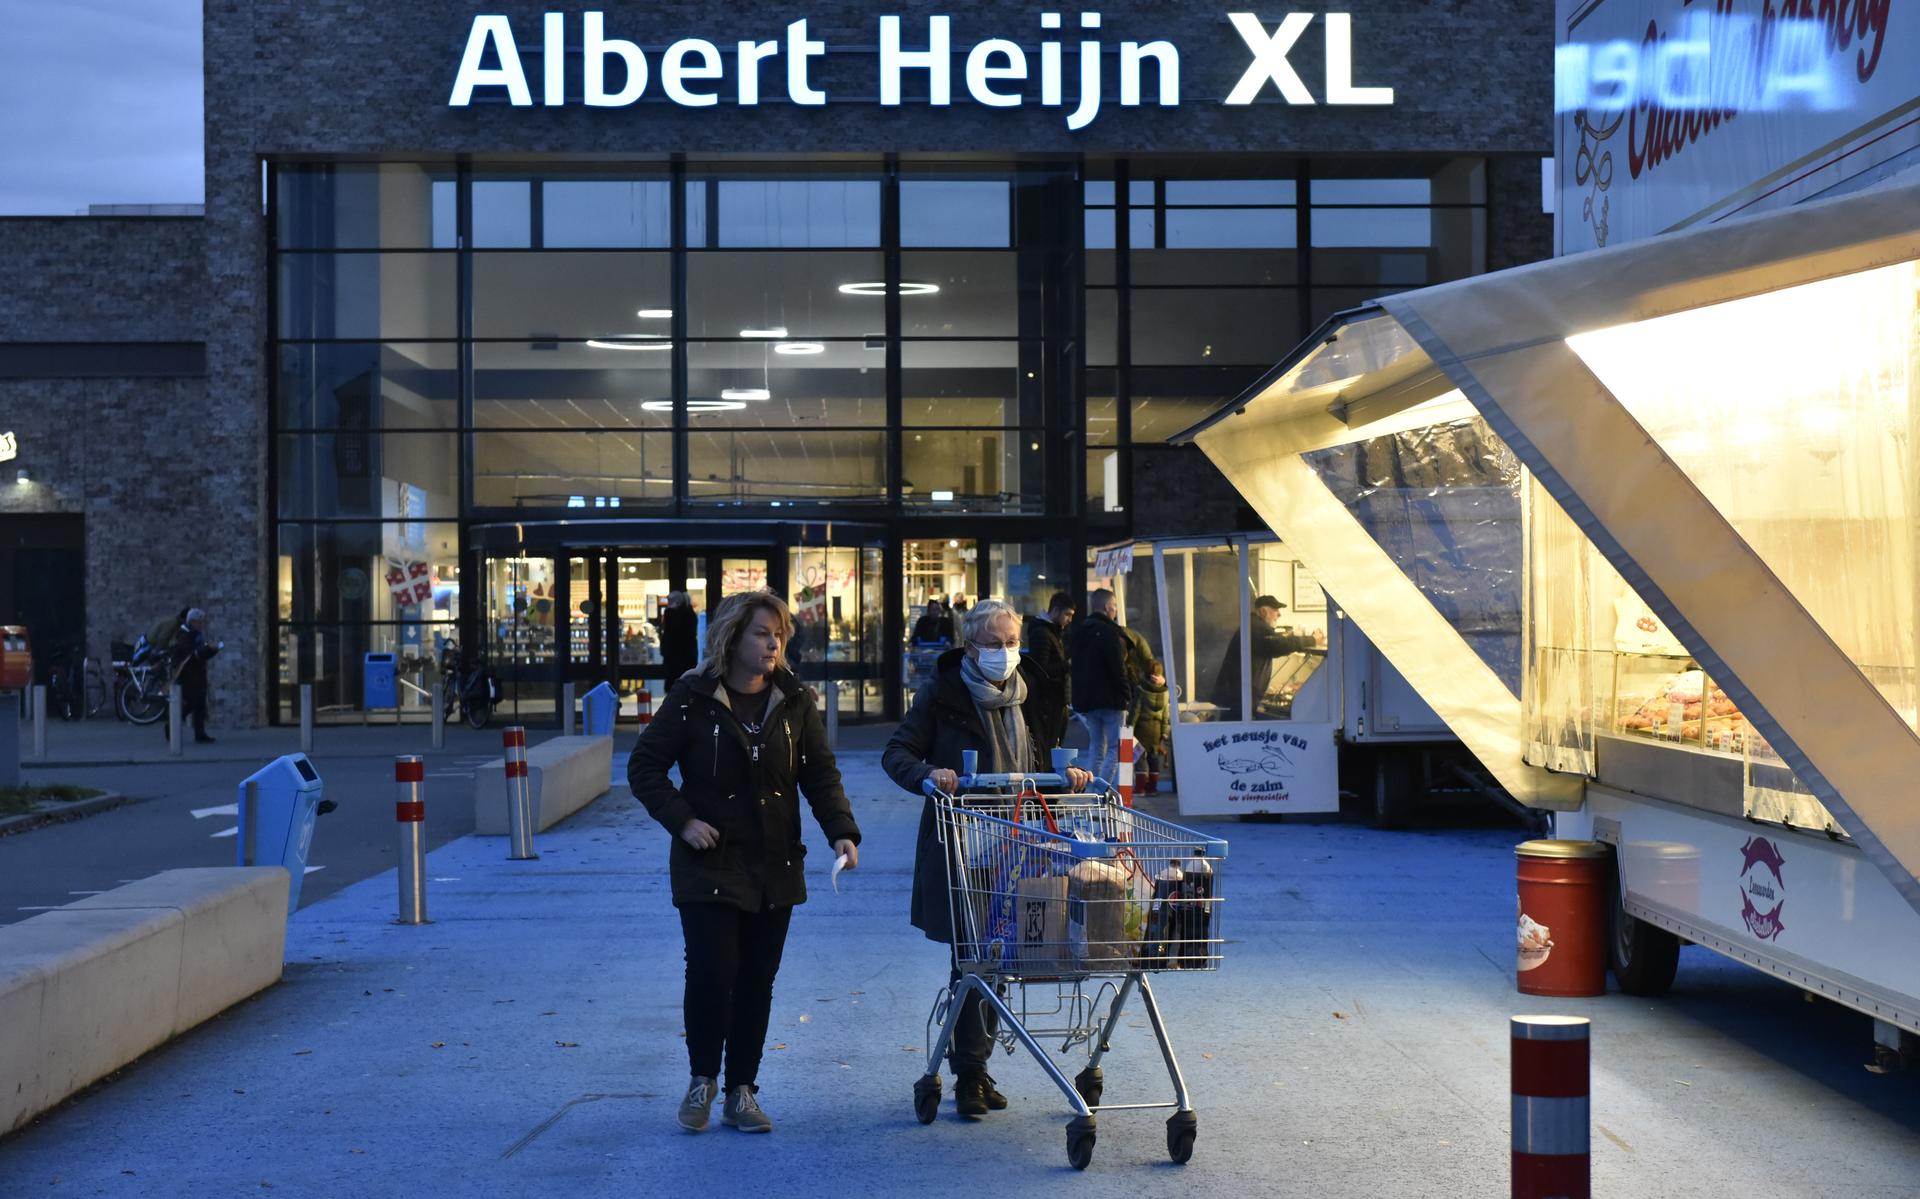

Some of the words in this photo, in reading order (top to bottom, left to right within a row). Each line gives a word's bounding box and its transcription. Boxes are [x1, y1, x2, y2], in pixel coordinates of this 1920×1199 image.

[448, 11, 827, 107] Albert
[879, 12, 1180, 131] Heijn
[1224, 12, 1394, 105] XL
[1203, 734, 1228, 752] het
[1232, 728, 1279, 745] neusje
[1282, 733, 1308, 751] van
[1230, 779, 1247, 792] de
[1250, 780, 1284, 793] zalm
